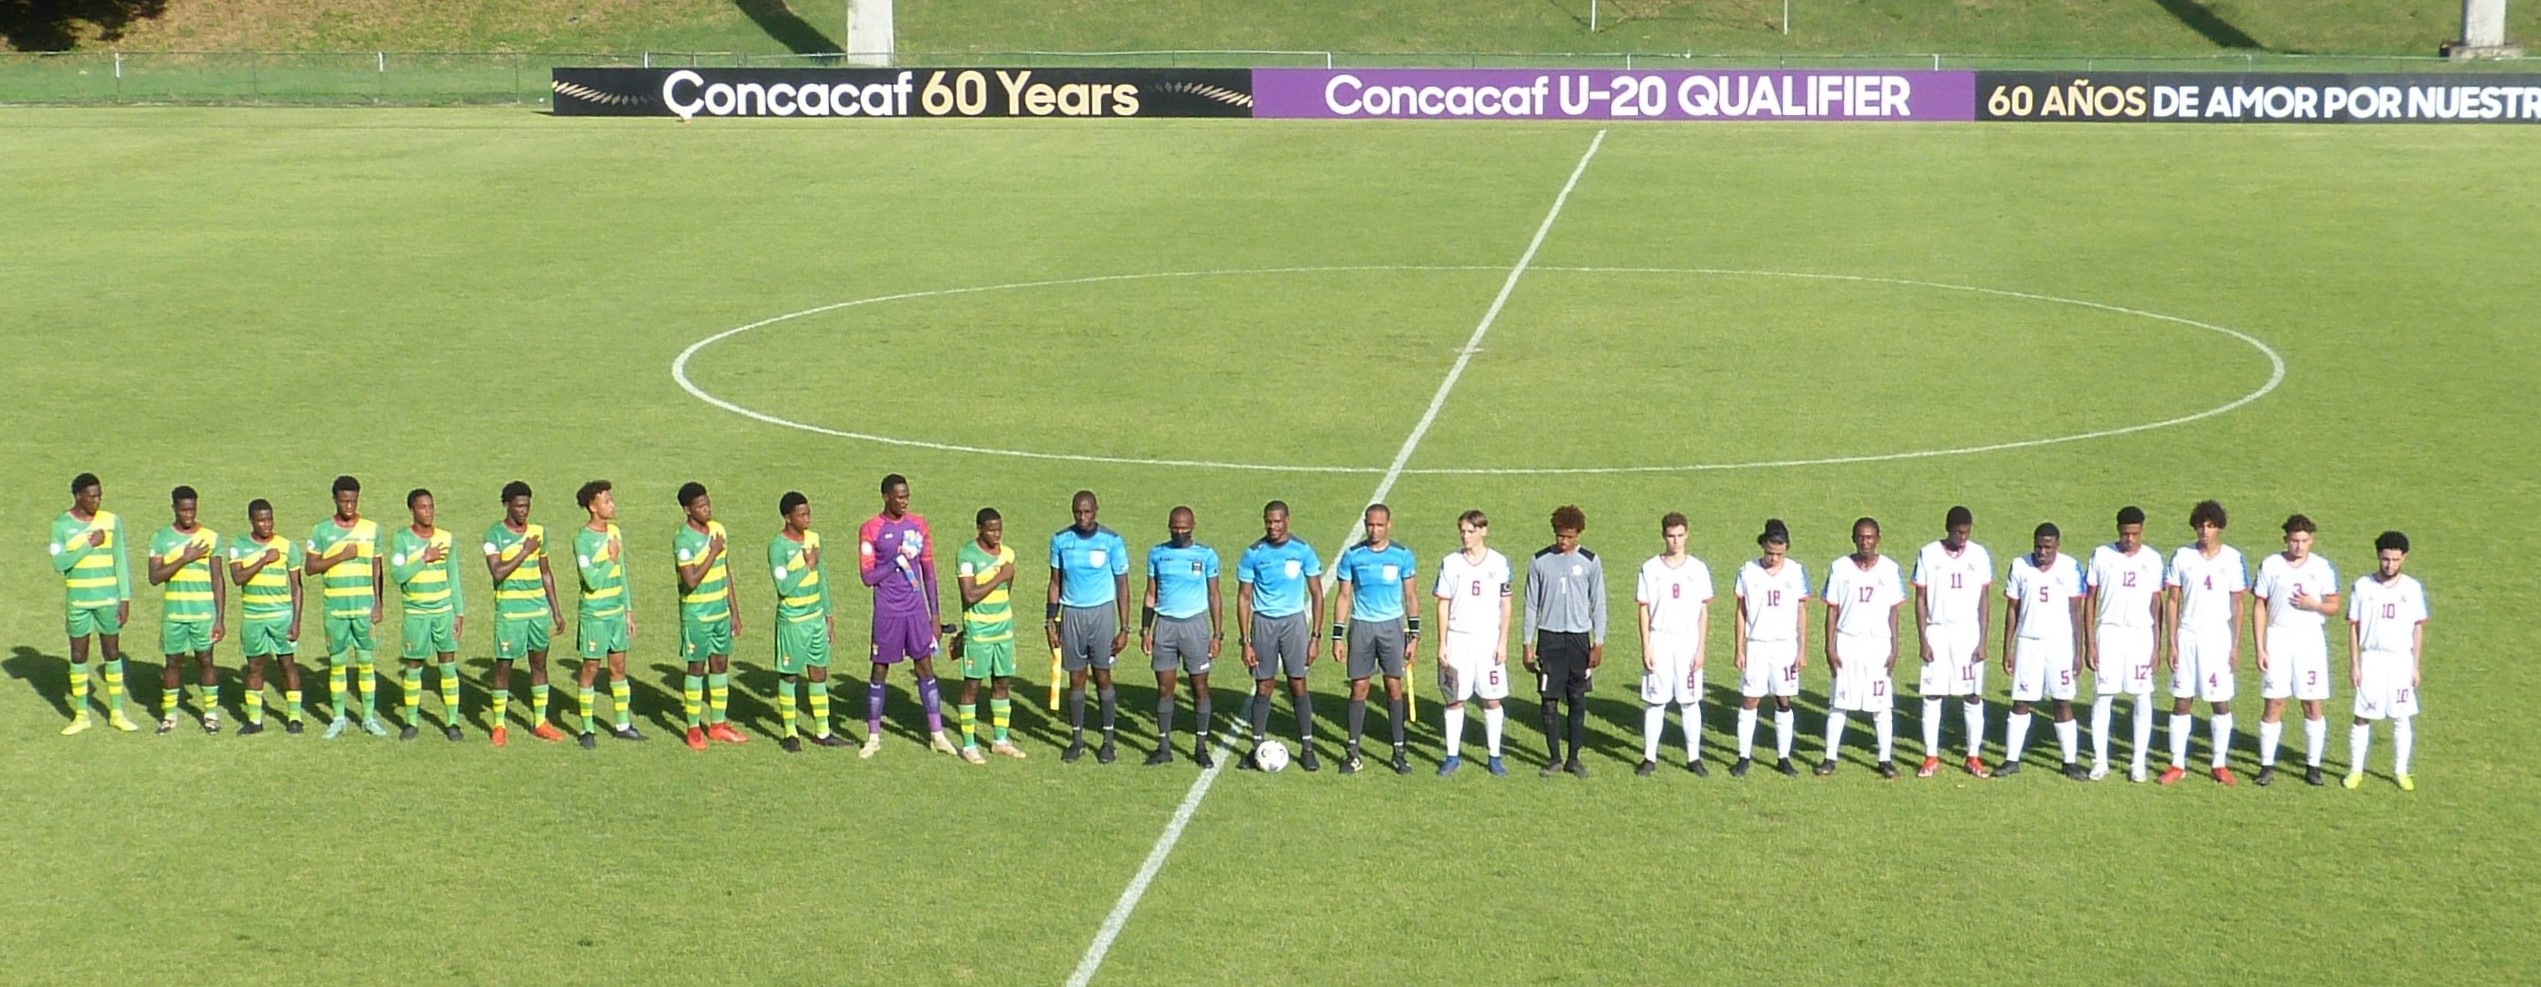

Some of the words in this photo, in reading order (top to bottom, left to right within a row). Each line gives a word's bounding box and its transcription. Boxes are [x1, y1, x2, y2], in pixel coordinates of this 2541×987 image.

[662, 71, 912, 116] Concacaf
[921, 72, 985, 116] 60
[996, 71, 1139, 116] Years
[1325, 74, 1548, 116] Concacaf
[1558, 76, 1667, 116] U-20
[1677, 76, 1912, 117] QUALIFIER
[1987, 85, 2031, 117] 60
[2040, 79, 2146, 118] AÑOS
[2153, 86, 2199, 118] DE
[2204, 86, 2317, 119] AMOR
[2324, 87, 2401, 119] POR
[1472, 580, 1481, 596] 6
[1560, 576, 1566, 594] 1
[1951, 573, 1962, 589] 11
[2122, 572, 2135, 588] 12
[2204, 575, 2213, 591] 4
[1672, 583, 1680, 599] 8
[1860, 586, 1873, 602] 17
[2039, 586, 2048, 603] 5
[2382, 603, 2395, 619] 10
[1490, 671, 1498, 686] 6
[1962, 665, 1974, 681] 11
[2061, 670, 2069, 685] 5
[2135, 664, 2149, 680] 12
[2307, 671, 2316, 686] 3
[1873, 681, 1885, 696] 17
[2209, 673, 2217, 688] 4
[2396, 688, 2409, 704] 10
